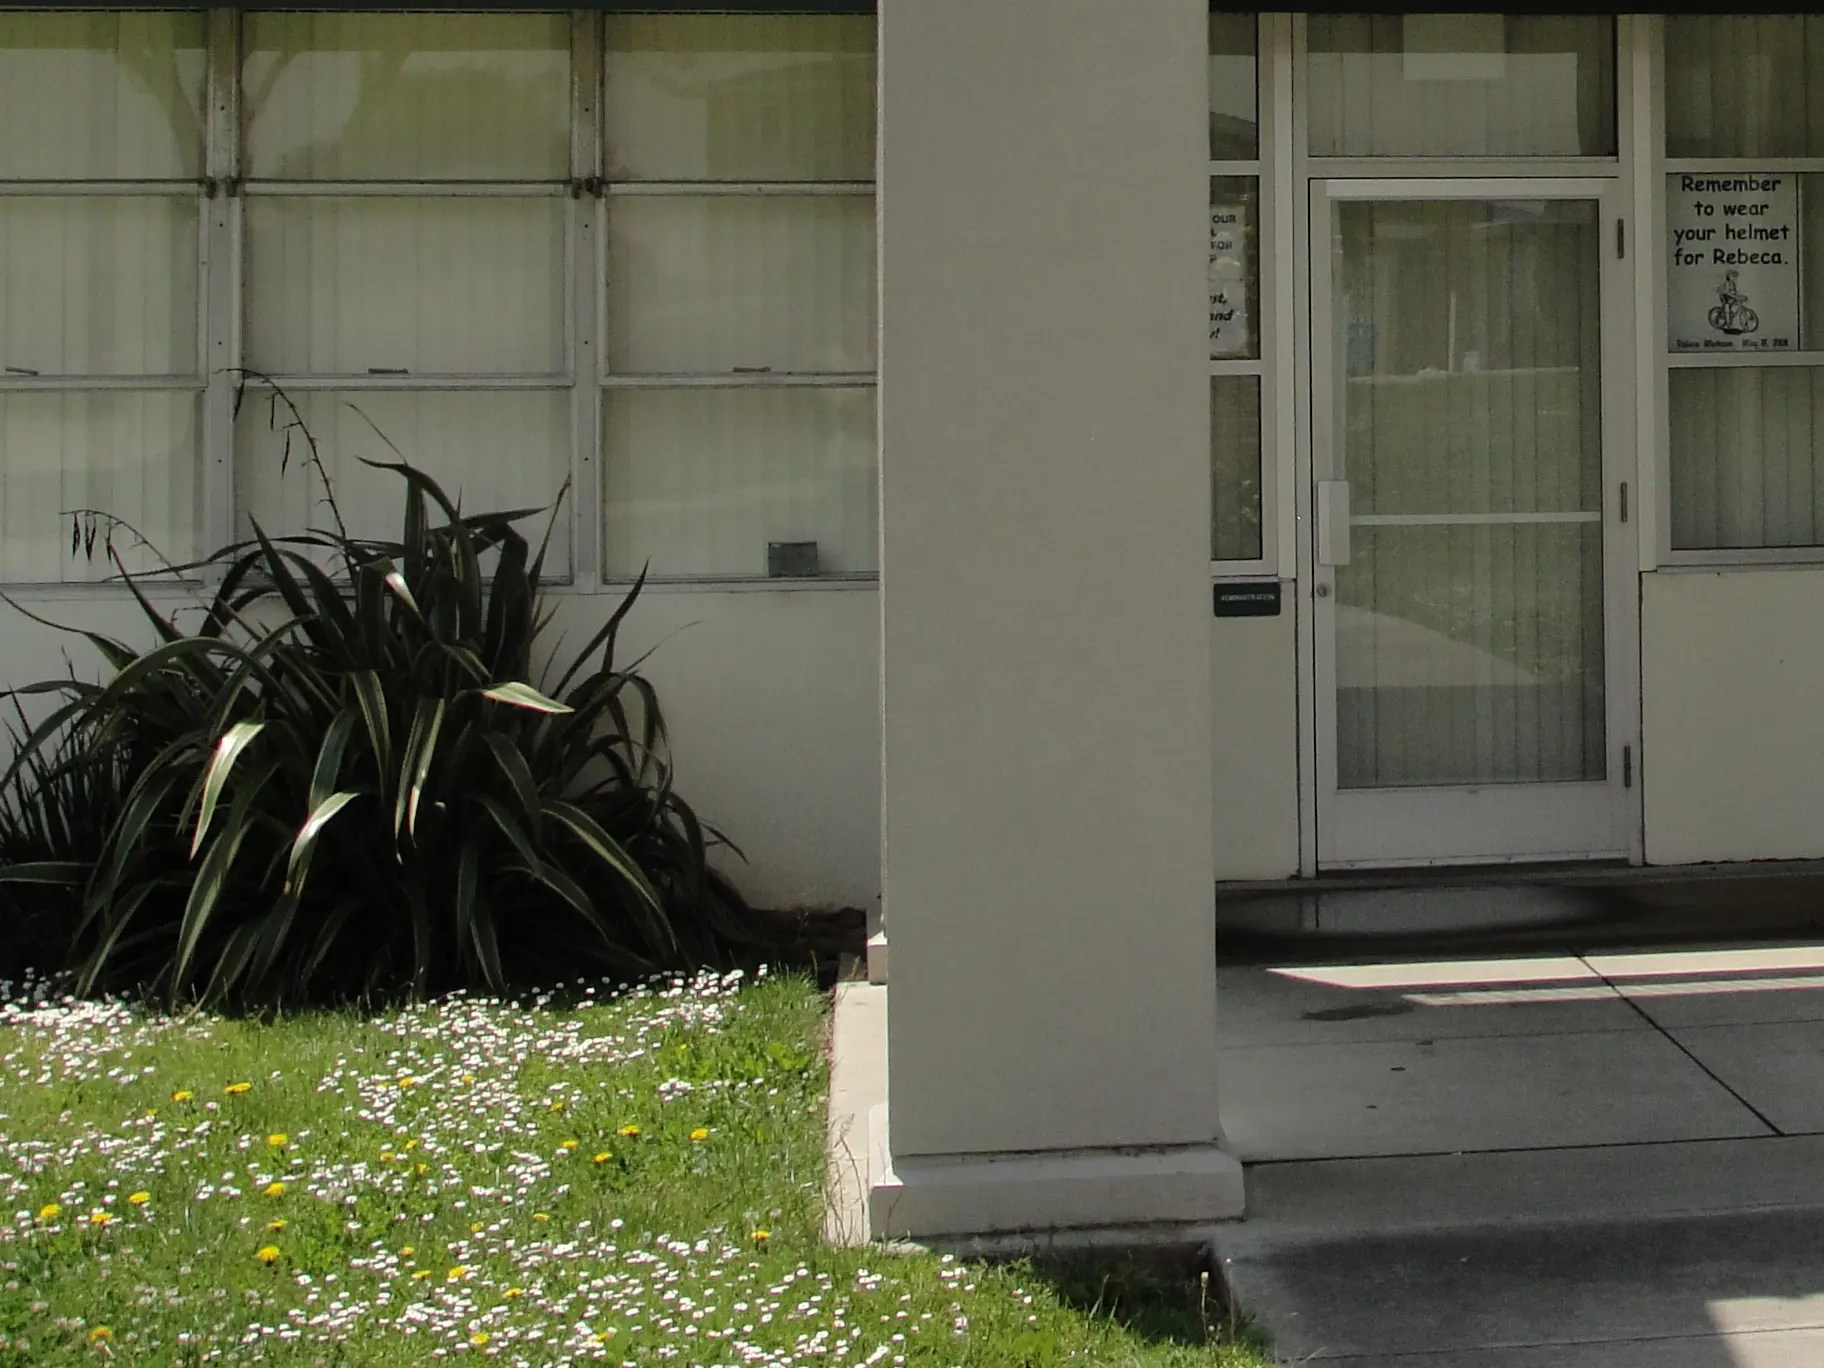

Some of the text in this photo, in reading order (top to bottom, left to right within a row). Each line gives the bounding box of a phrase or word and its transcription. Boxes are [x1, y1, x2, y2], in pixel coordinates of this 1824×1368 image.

[1681, 175, 1782, 192] Remember
[1694, 201, 1769, 216] to wear
[1674, 224, 1790, 246] your helmet
[1674, 248, 1789, 266] for Rebeca.
